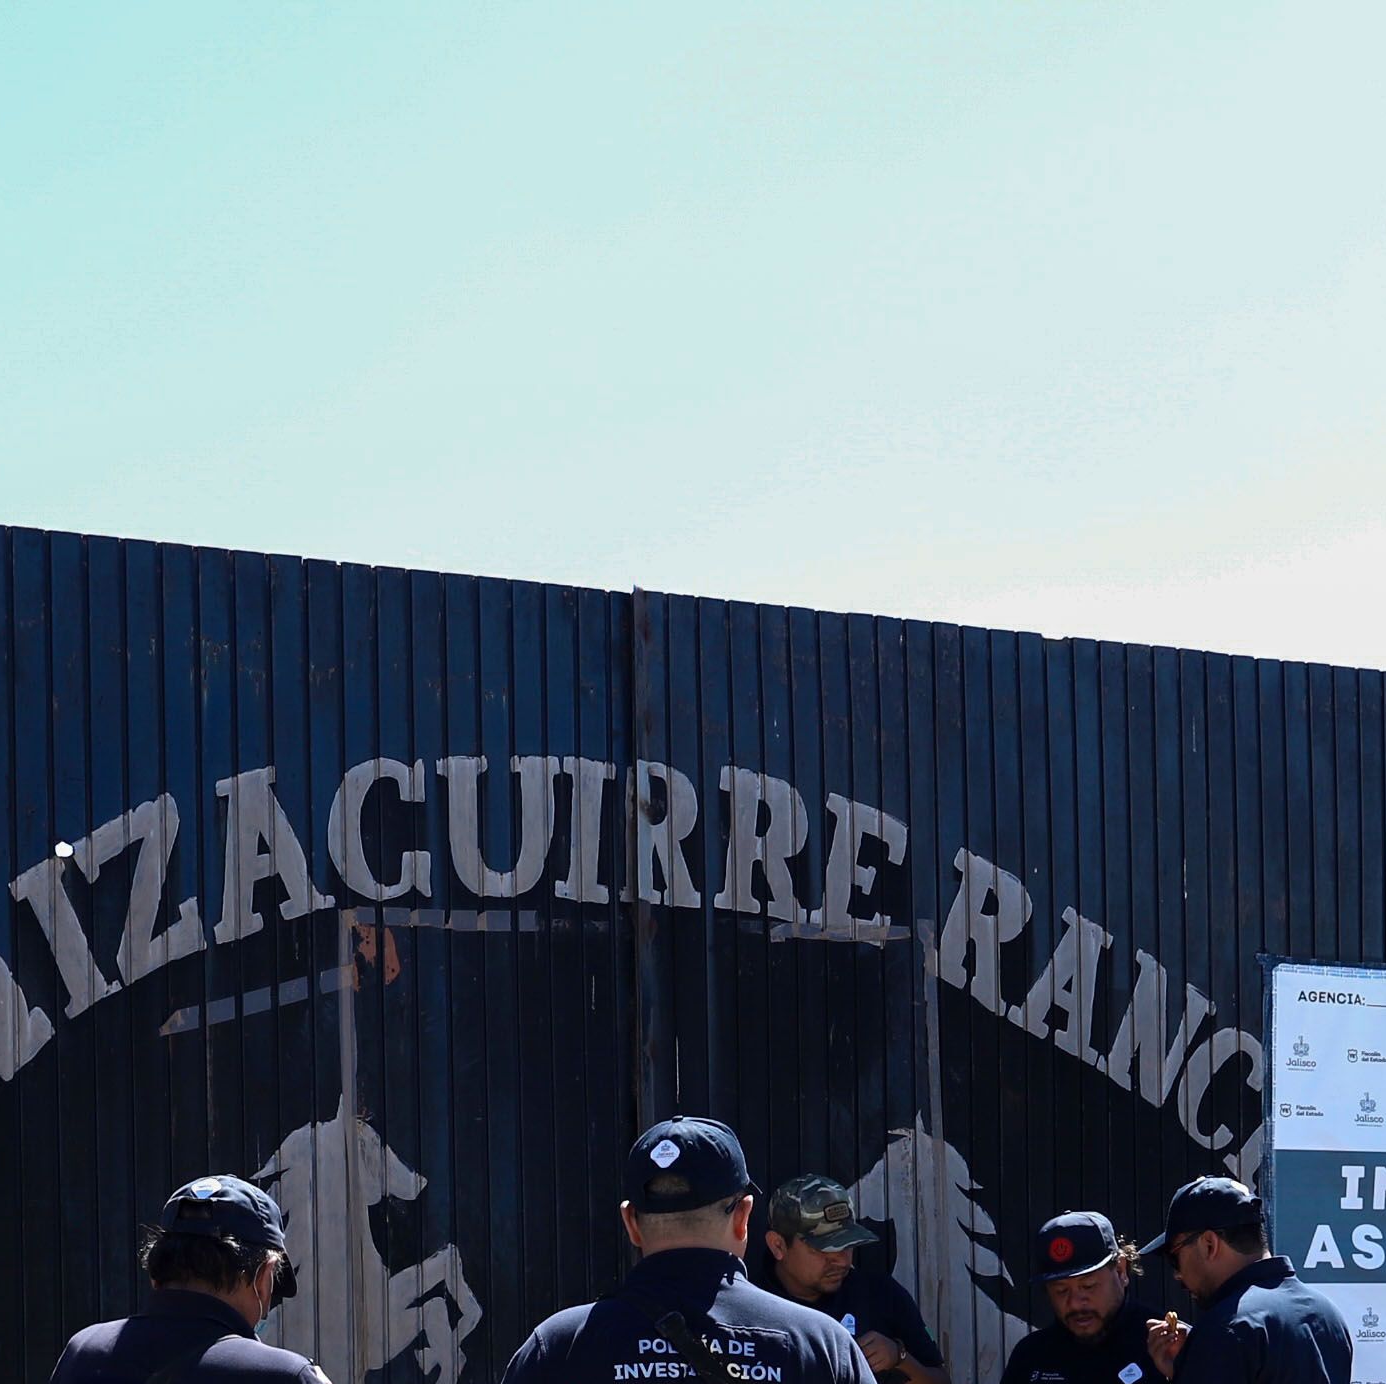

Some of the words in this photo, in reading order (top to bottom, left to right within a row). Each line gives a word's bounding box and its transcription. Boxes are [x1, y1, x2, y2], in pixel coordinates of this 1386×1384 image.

[1298, 991, 1365, 1005] AGENCIA:
[940, 847, 1264, 1192] RANC
[1286, 1058, 1316, 1067] Jalisco
[1354, 1114, 1384, 1123] Jalisco
[1356, 1330, 1386, 1338] Jalisco
[729, 1340, 755, 1357] DE
